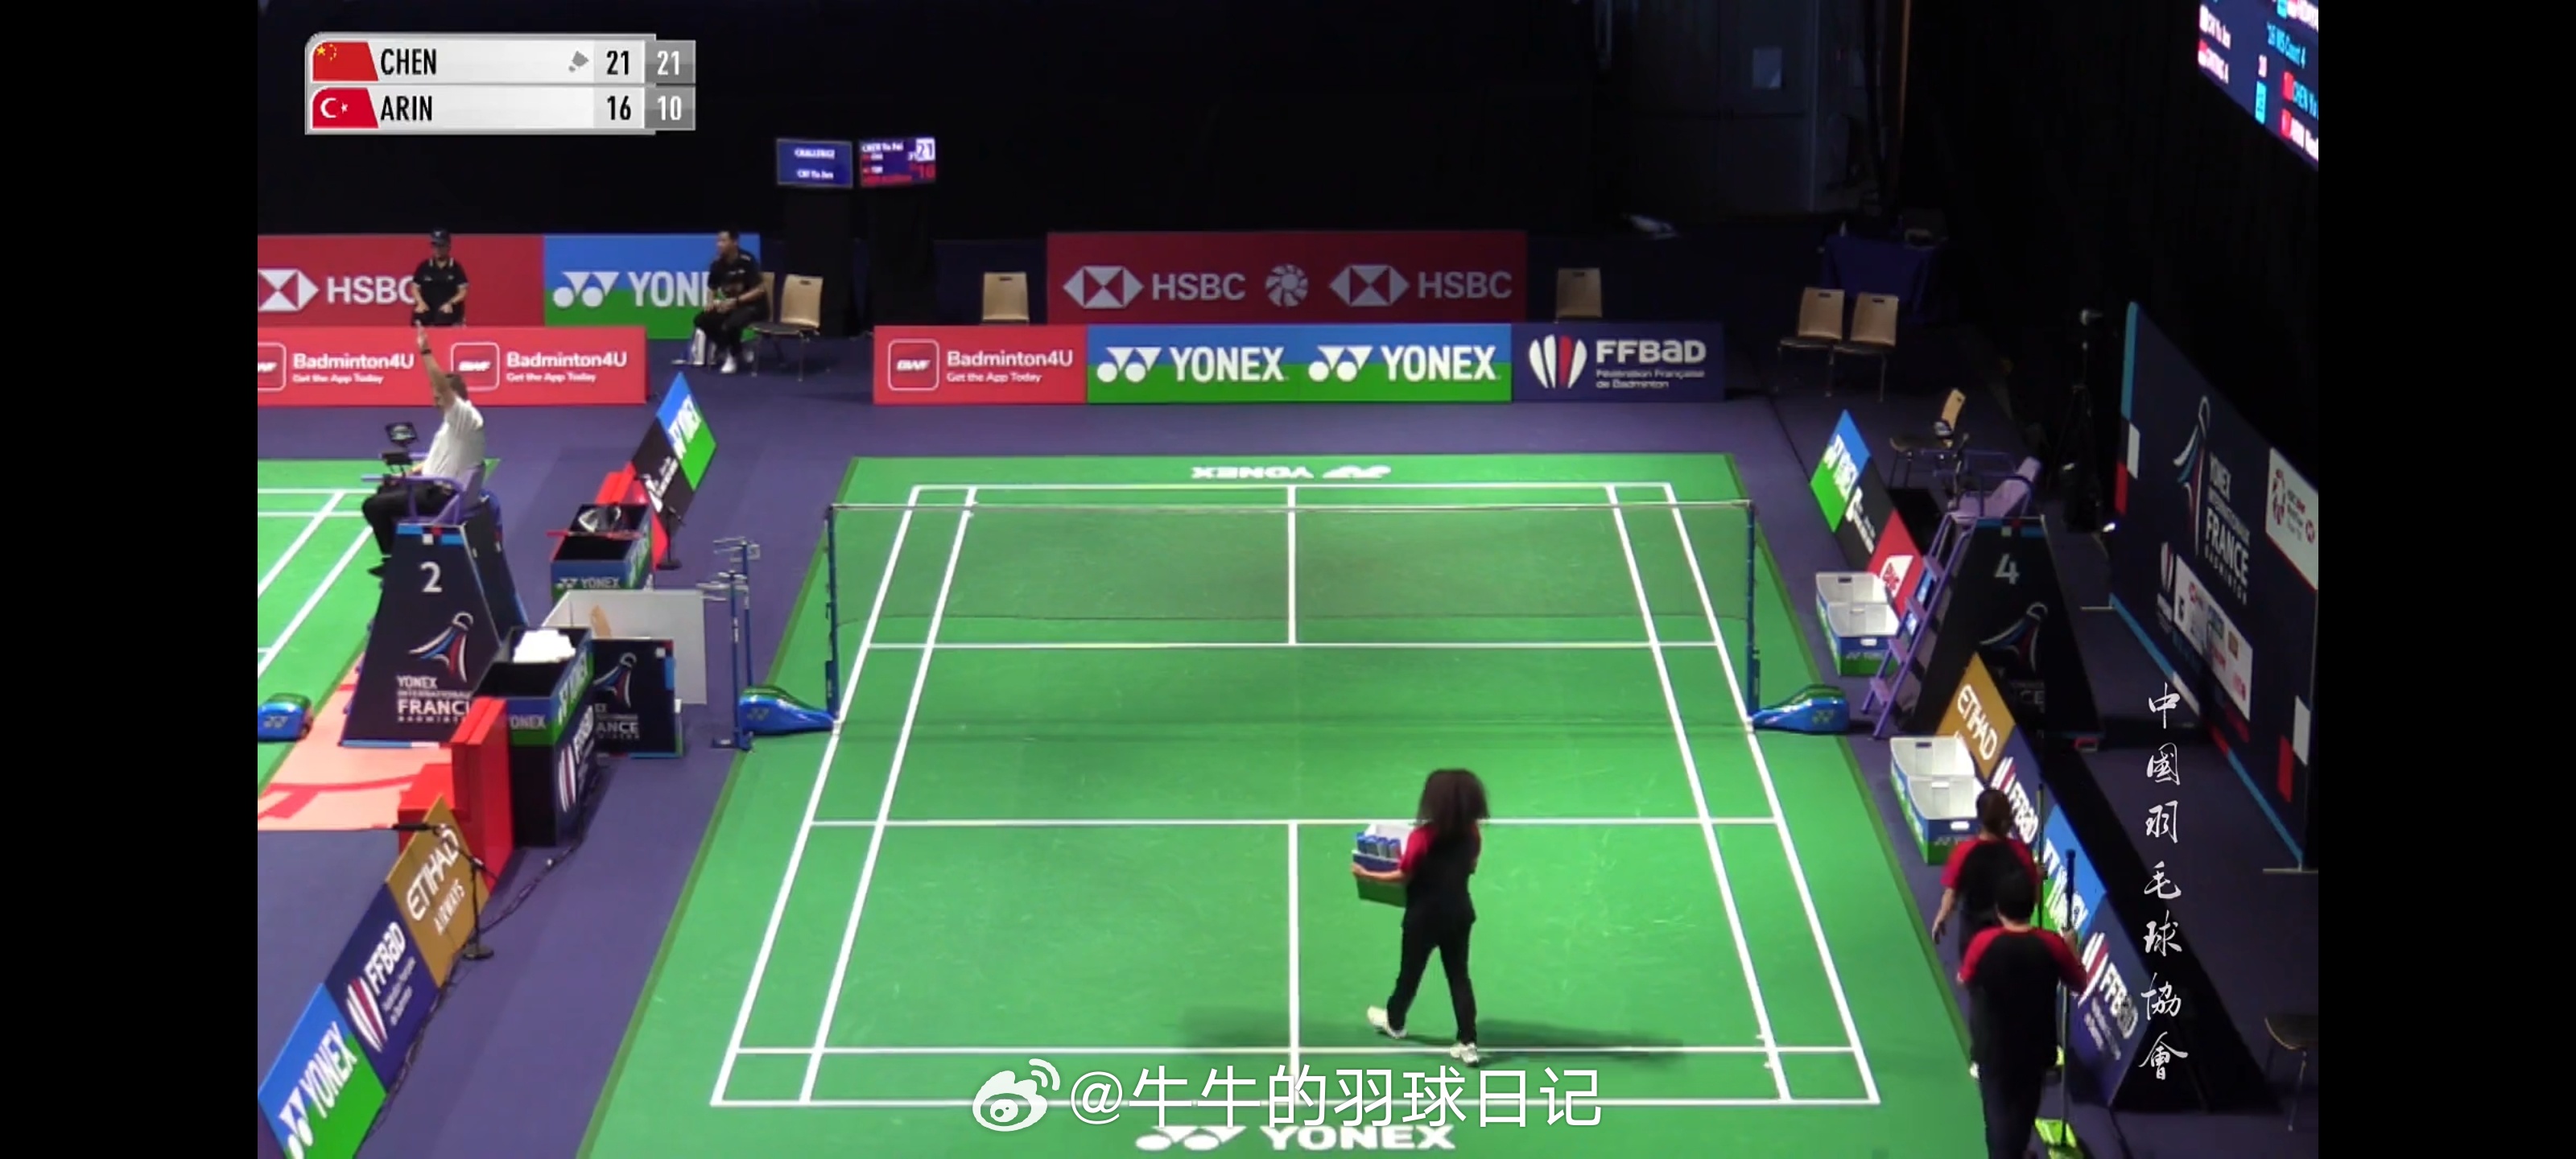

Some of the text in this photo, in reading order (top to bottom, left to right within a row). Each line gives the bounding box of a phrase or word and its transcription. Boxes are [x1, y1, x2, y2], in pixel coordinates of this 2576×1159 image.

[917, 142, 934, 159] 21
[628, 270, 711, 307] YON
[1152, 273, 1246, 301] HSBC
[1418, 271, 1513, 299] HSBC
[293, 353, 415, 369] Badminton4U
[506, 352, 627, 368] Badminton4U
[947, 349, 1073, 367] Badminton4U
[1169, 346, 1285, 382] YONEX
[1381, 345, 1496, 382] YONEX
[330, 373, 352, 385] App
[353, 373, 385, 385] Today
[544, 373, 566, 384] App
[568, 372, 597, 383] Today
[947, 372, 1042, 384] Get the App Today
[2206, 506, 2249, 588] FRANCE
[420, 561, 443, 593] 2
[1994, 553, 2020, 584] 4
[396, 675, 438, 689] YONEX
[509, 715, 547, 730] ONEX
[1958, 684, 1998, 761] ETIHAD
[407, 828, 460, 921] ETIHAD
[299, 1021, 357, 1119] YONEX
[1260, 1124, 1456, 1151] YONEX
